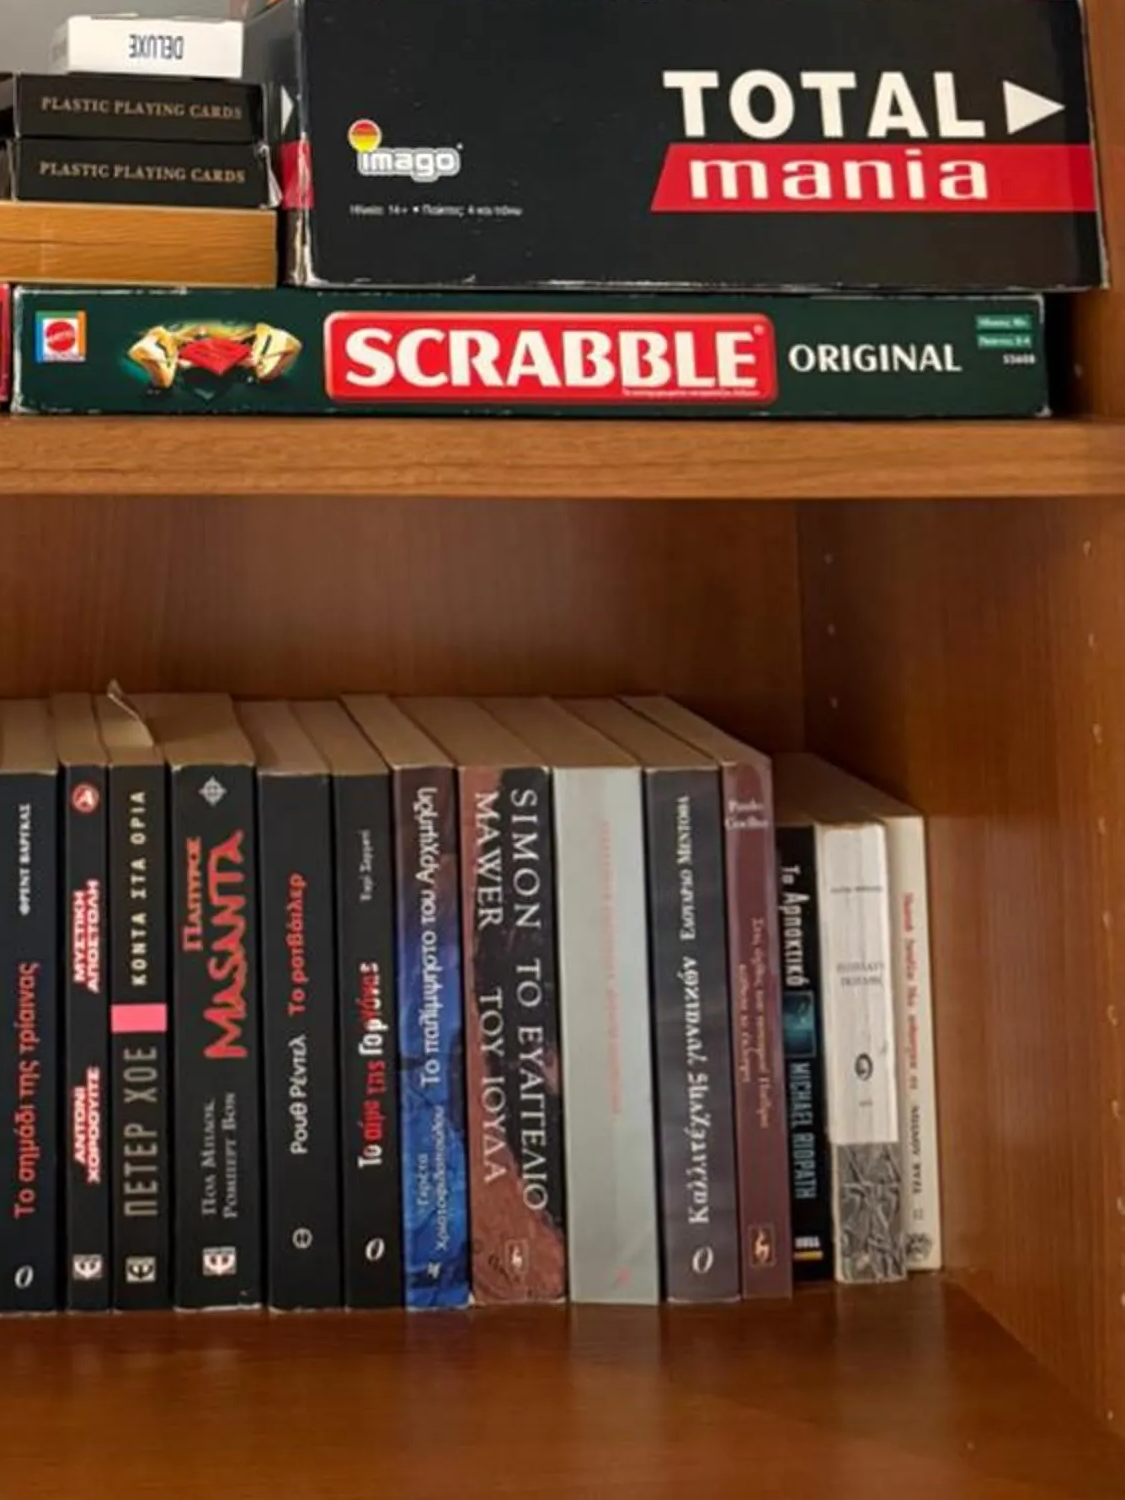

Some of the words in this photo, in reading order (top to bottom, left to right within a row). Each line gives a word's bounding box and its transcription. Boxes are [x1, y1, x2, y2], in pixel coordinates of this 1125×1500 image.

[129, 34, 184, 59] DELUXE
[41, 97, 109, 113] PLASTIC
[114, 99, 185, 117] PLAYING
[189, 102, 242, 120] CARDS
[663, 69, 986, 138] TOTAL
[39, 161, 110, 179] PLASTIC
[113, 164, 186, 181] PLAYING
[191, 167, 246, 184] CARDS
[361, 151, 456, 177] imago
[688, 148, 989, 200] mania
[345, 327, 757, 389] SCRABBLE
[788, 342, 962, 374] ORIGINAL
[18, 803, 32, 864] ΒΑΡΓΚΑΣ
[130, 790, 147, 845] ΟΡΙΑ
[413, 787, 440, 884] Αρχιμήδη
[18, 867, 32, 915] ΦΡΕΝΤ
[130, 857, 147, 899] ΣΤΑ
[474, 792, 504, 930] MAWER
[511, 789, 543, 929] SIMON
[780, 866, 800, 885] Το
[183, 836, 204, 951] ΠΑΠΥΡΟΣ
[420, 889, 435, 924] του
[73, 890, 87, 983] ΜΥΣΤΙΚΗ
[86, 879, 101, 994] ΑΠΟΣΤΟΛΗ
[131, 912, 148, 986] ΚΟΝΤΑ
[287, 873, 308, 984] ροτβάιλερ
[779, 891, 811, 987] Αρπακτικό
[16, 963, 40, 1054] τρίαινας
[287, 988, 305, 1015] Το
[356, 962, 388, 1056] Γοργόνας
[419, 930, 443, 1053] παλίμψηστο
[516, 958, 544, 1008] ΤΟ
[678, 956, 706, 1066] γυναικών
[477, 986, 506, 1057] ΤΟΥ
[17, 1060, 40, 1096] της
[123, 1046, 158, 1103] ΧΟΕ
[287, 1035, 308, 1099] Ρέντελ
[366, 1060, 386, 1095] της
[420, 1058, 441, 1087] Το
[788, 1062, 812, 1129] MICHAEL
[13, 1103, 38, 1182] σημάδι
[73, 1086, 87, 1165] ΑΝΤΟΝΙ
[289, 1102, 309, 1154] Ρουθ
[358, 1102, 381, 1141] αίμα
[482, 1076, 509, 1183] ΙΟΥΔΑ
[518, 1026, 549, 1211] ΕΥΑΓΓΕΛΙΟ
[684, 1073, 711, 1224] Καλλιτέχνης
[123, 1122, 159, 1216] ΠΕΤΕΡ
[221, 1138, 239, 1219] ΡΟΜΠΕΡΤ
[357, 1144, 382, 1168] Το
[792, 1133, 816, 1199] RIDPATH
[14, 1189, 35, 1218] Το
